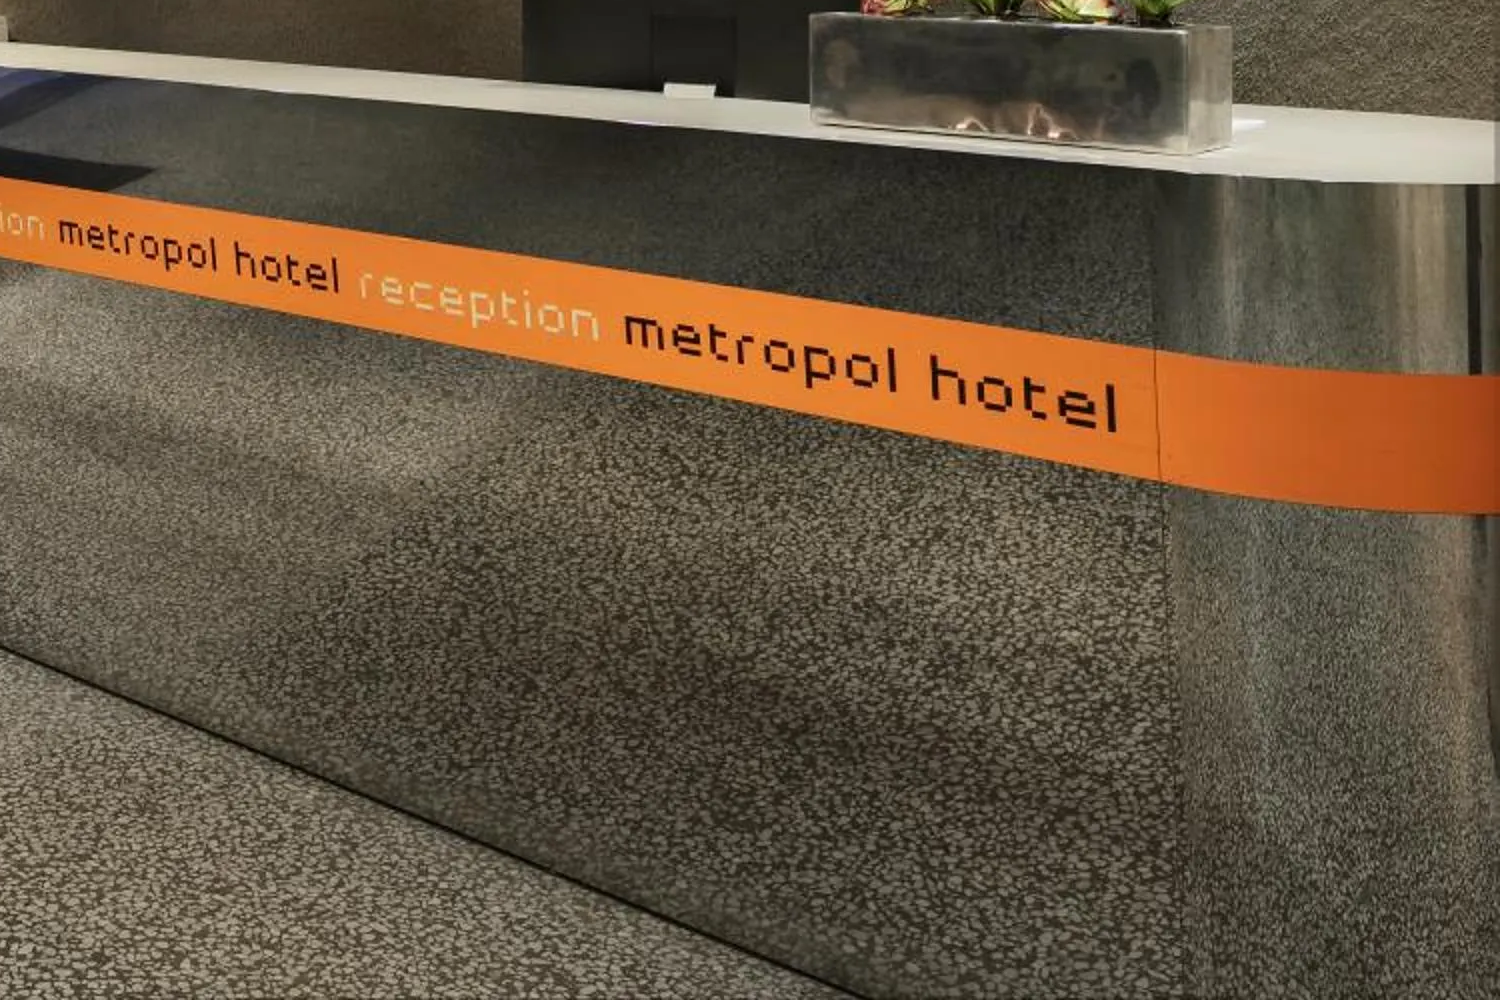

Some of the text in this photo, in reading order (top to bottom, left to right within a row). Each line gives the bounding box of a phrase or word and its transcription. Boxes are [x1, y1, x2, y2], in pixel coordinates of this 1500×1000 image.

[58, 219, 218, 272] metropol
[233, 240, 339, 294] hotel
[359, 269, 600, 340] reception
[624, 314, 897, 393] metropol
[930, 354, 1118, 433] hotel
